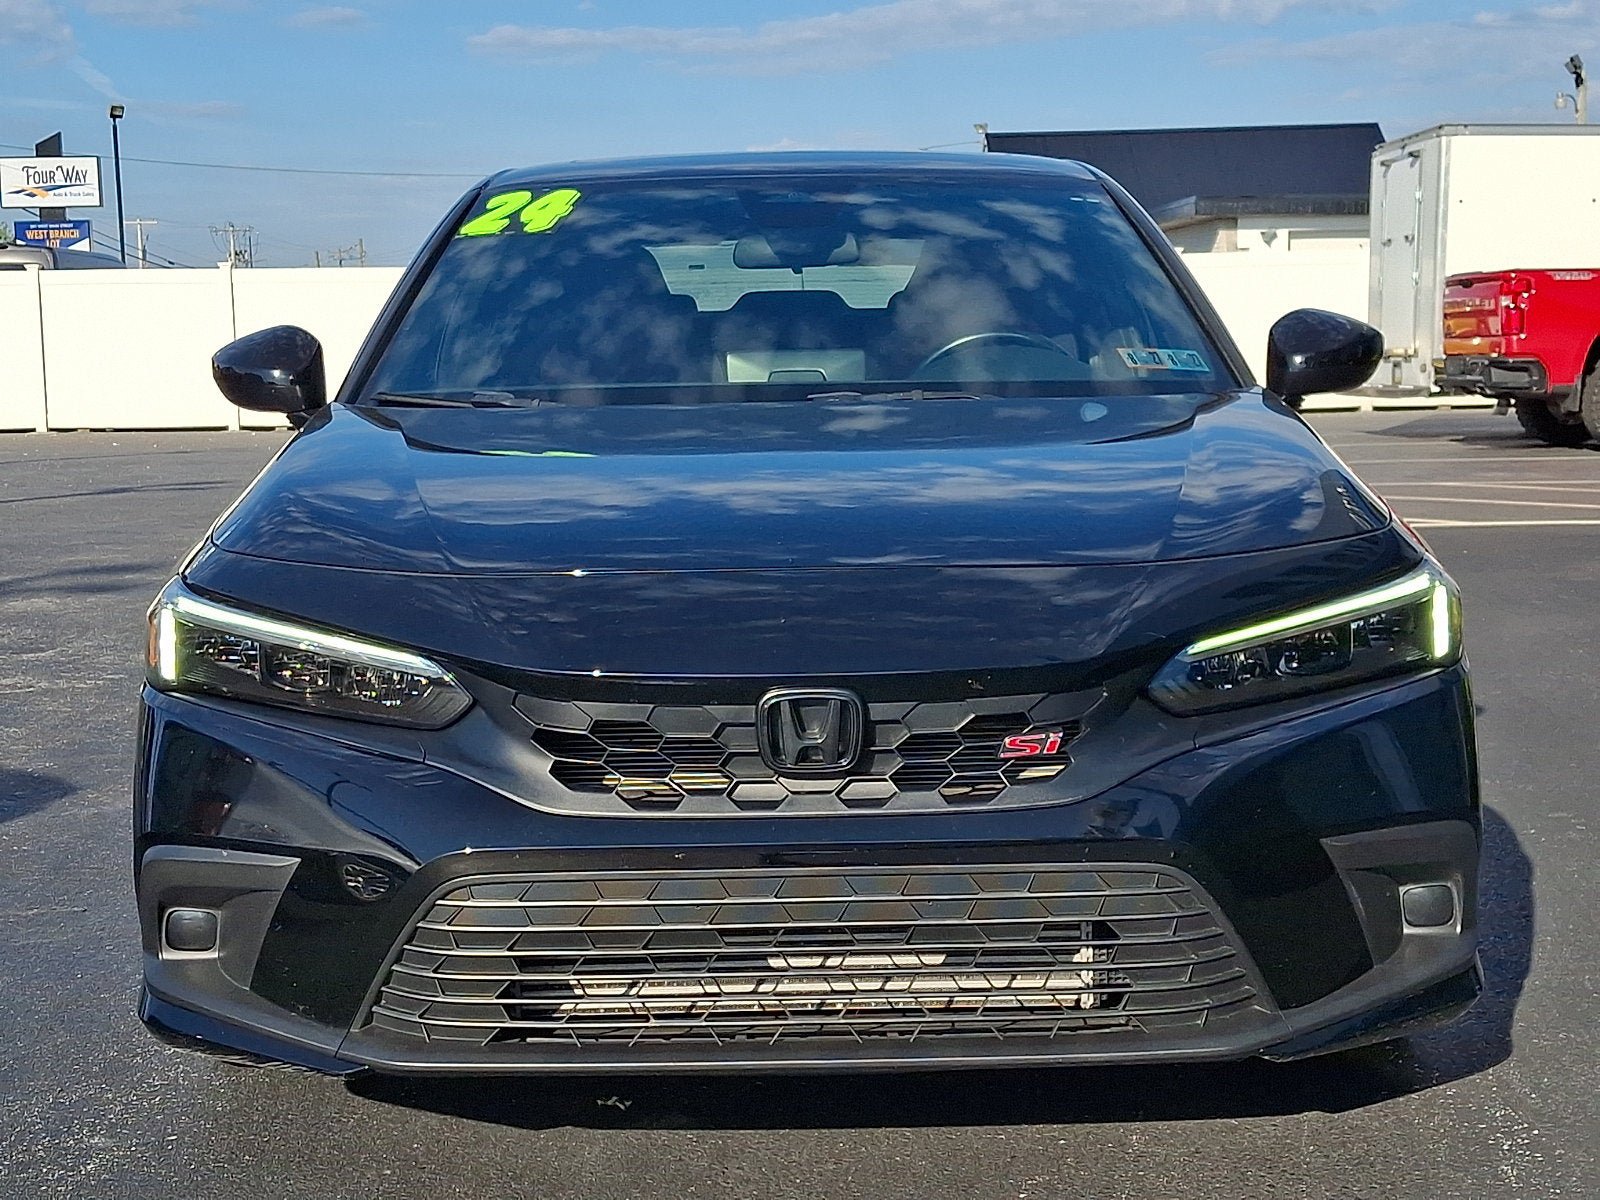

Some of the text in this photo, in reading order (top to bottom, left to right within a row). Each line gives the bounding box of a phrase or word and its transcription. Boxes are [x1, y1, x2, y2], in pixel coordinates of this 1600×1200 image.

[22, 165, 88, 185] FOUR WAY
[460, 189, 581, 236] 24
[26, 229, 79, 239] WEST BRANCH
[1000, 732, 1063, 758] Si
